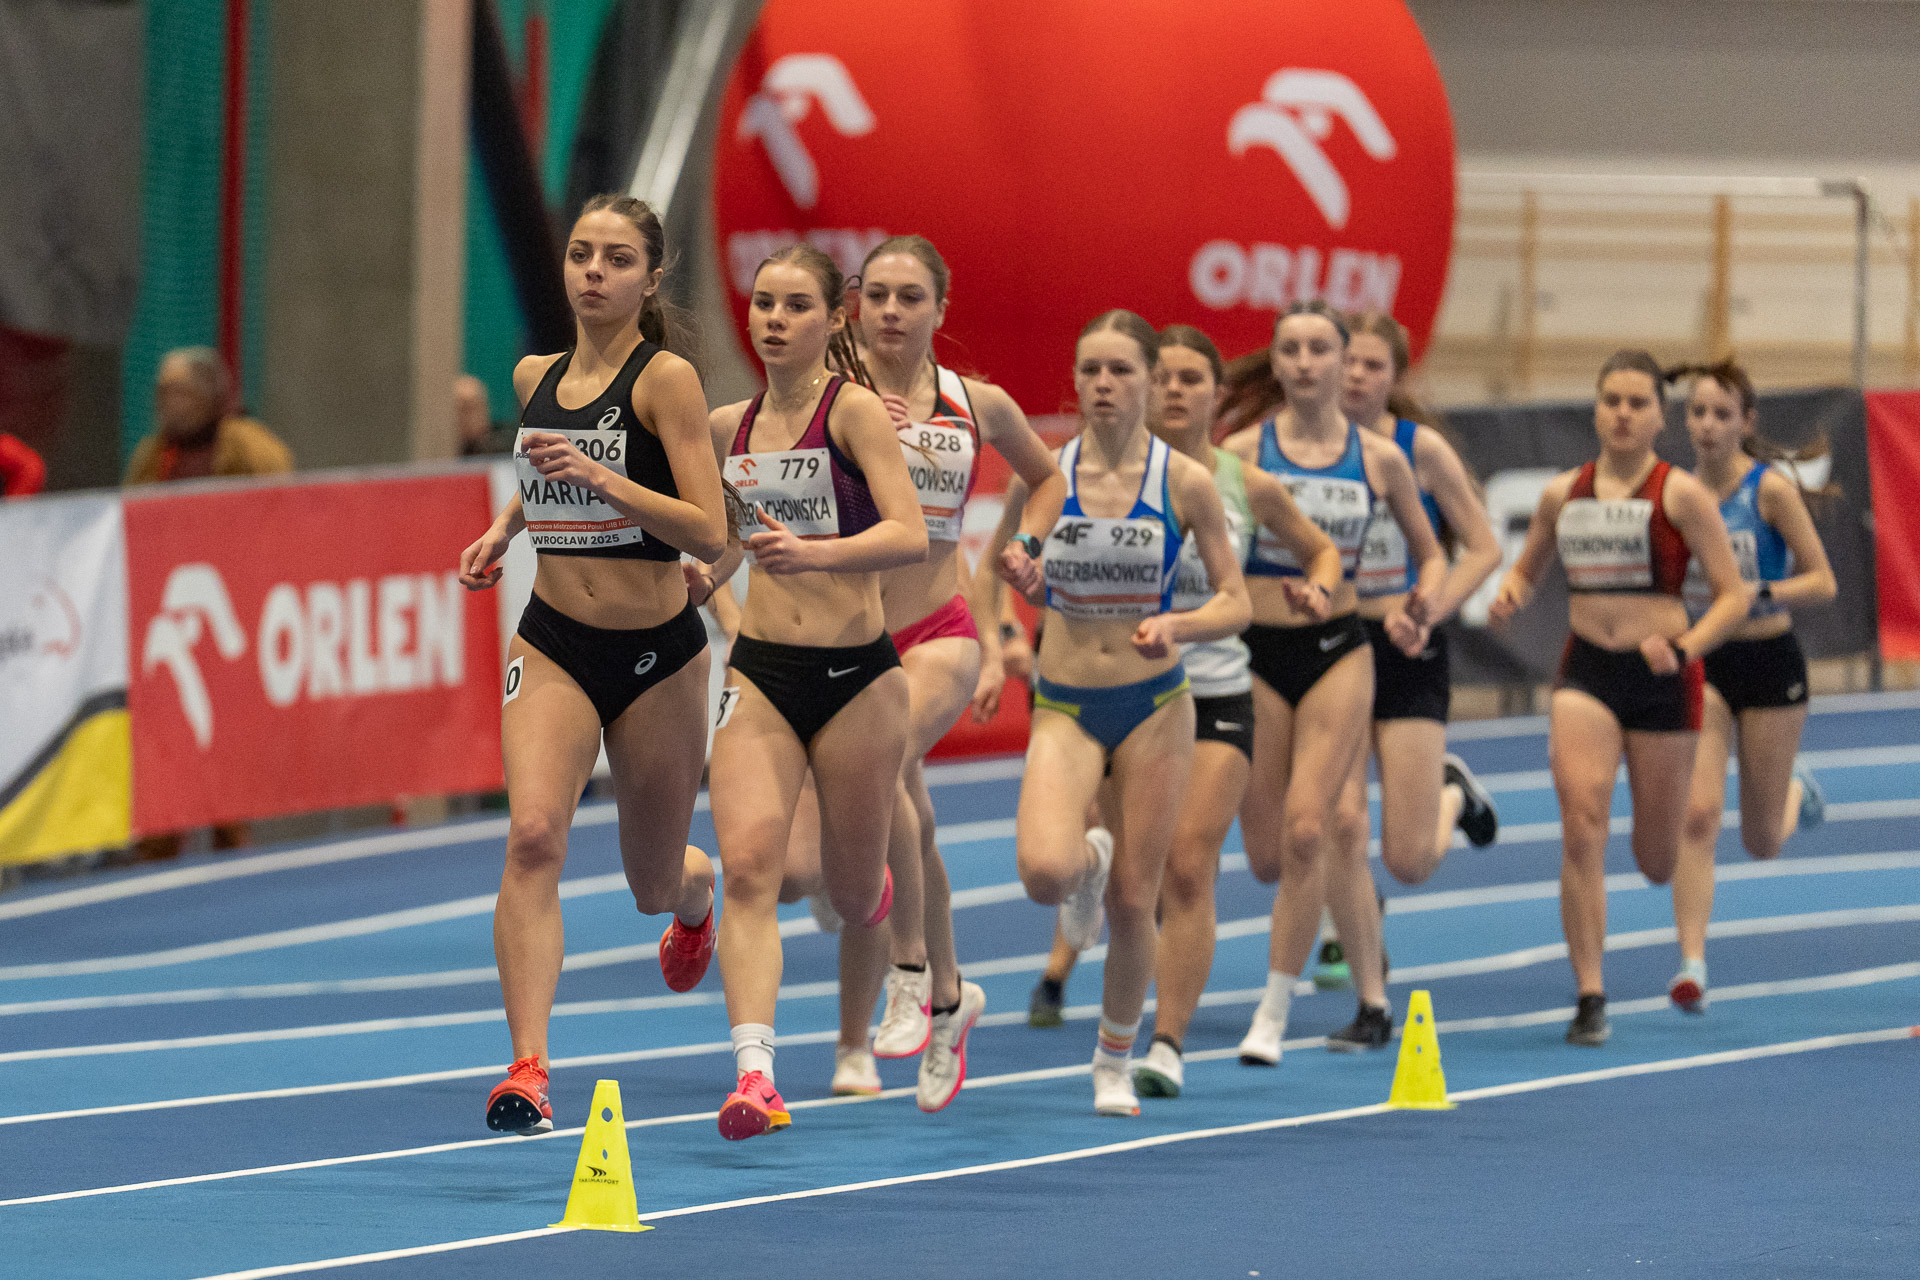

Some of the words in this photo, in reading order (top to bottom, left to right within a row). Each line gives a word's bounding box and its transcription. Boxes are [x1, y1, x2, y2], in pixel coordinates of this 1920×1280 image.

[568, 438, 621, 461] 306
[919, 431, 961, 452] 828
[780, 457, 819, 480] 779
[735, 479, 758, 487] ORLEN
[532, 535, 588, 545] WROCŁAW
[590, 534, 620, 545] 2025
[1110, 526, 1153, 547] 929
[258, 571, 465, 706] ORLEN
